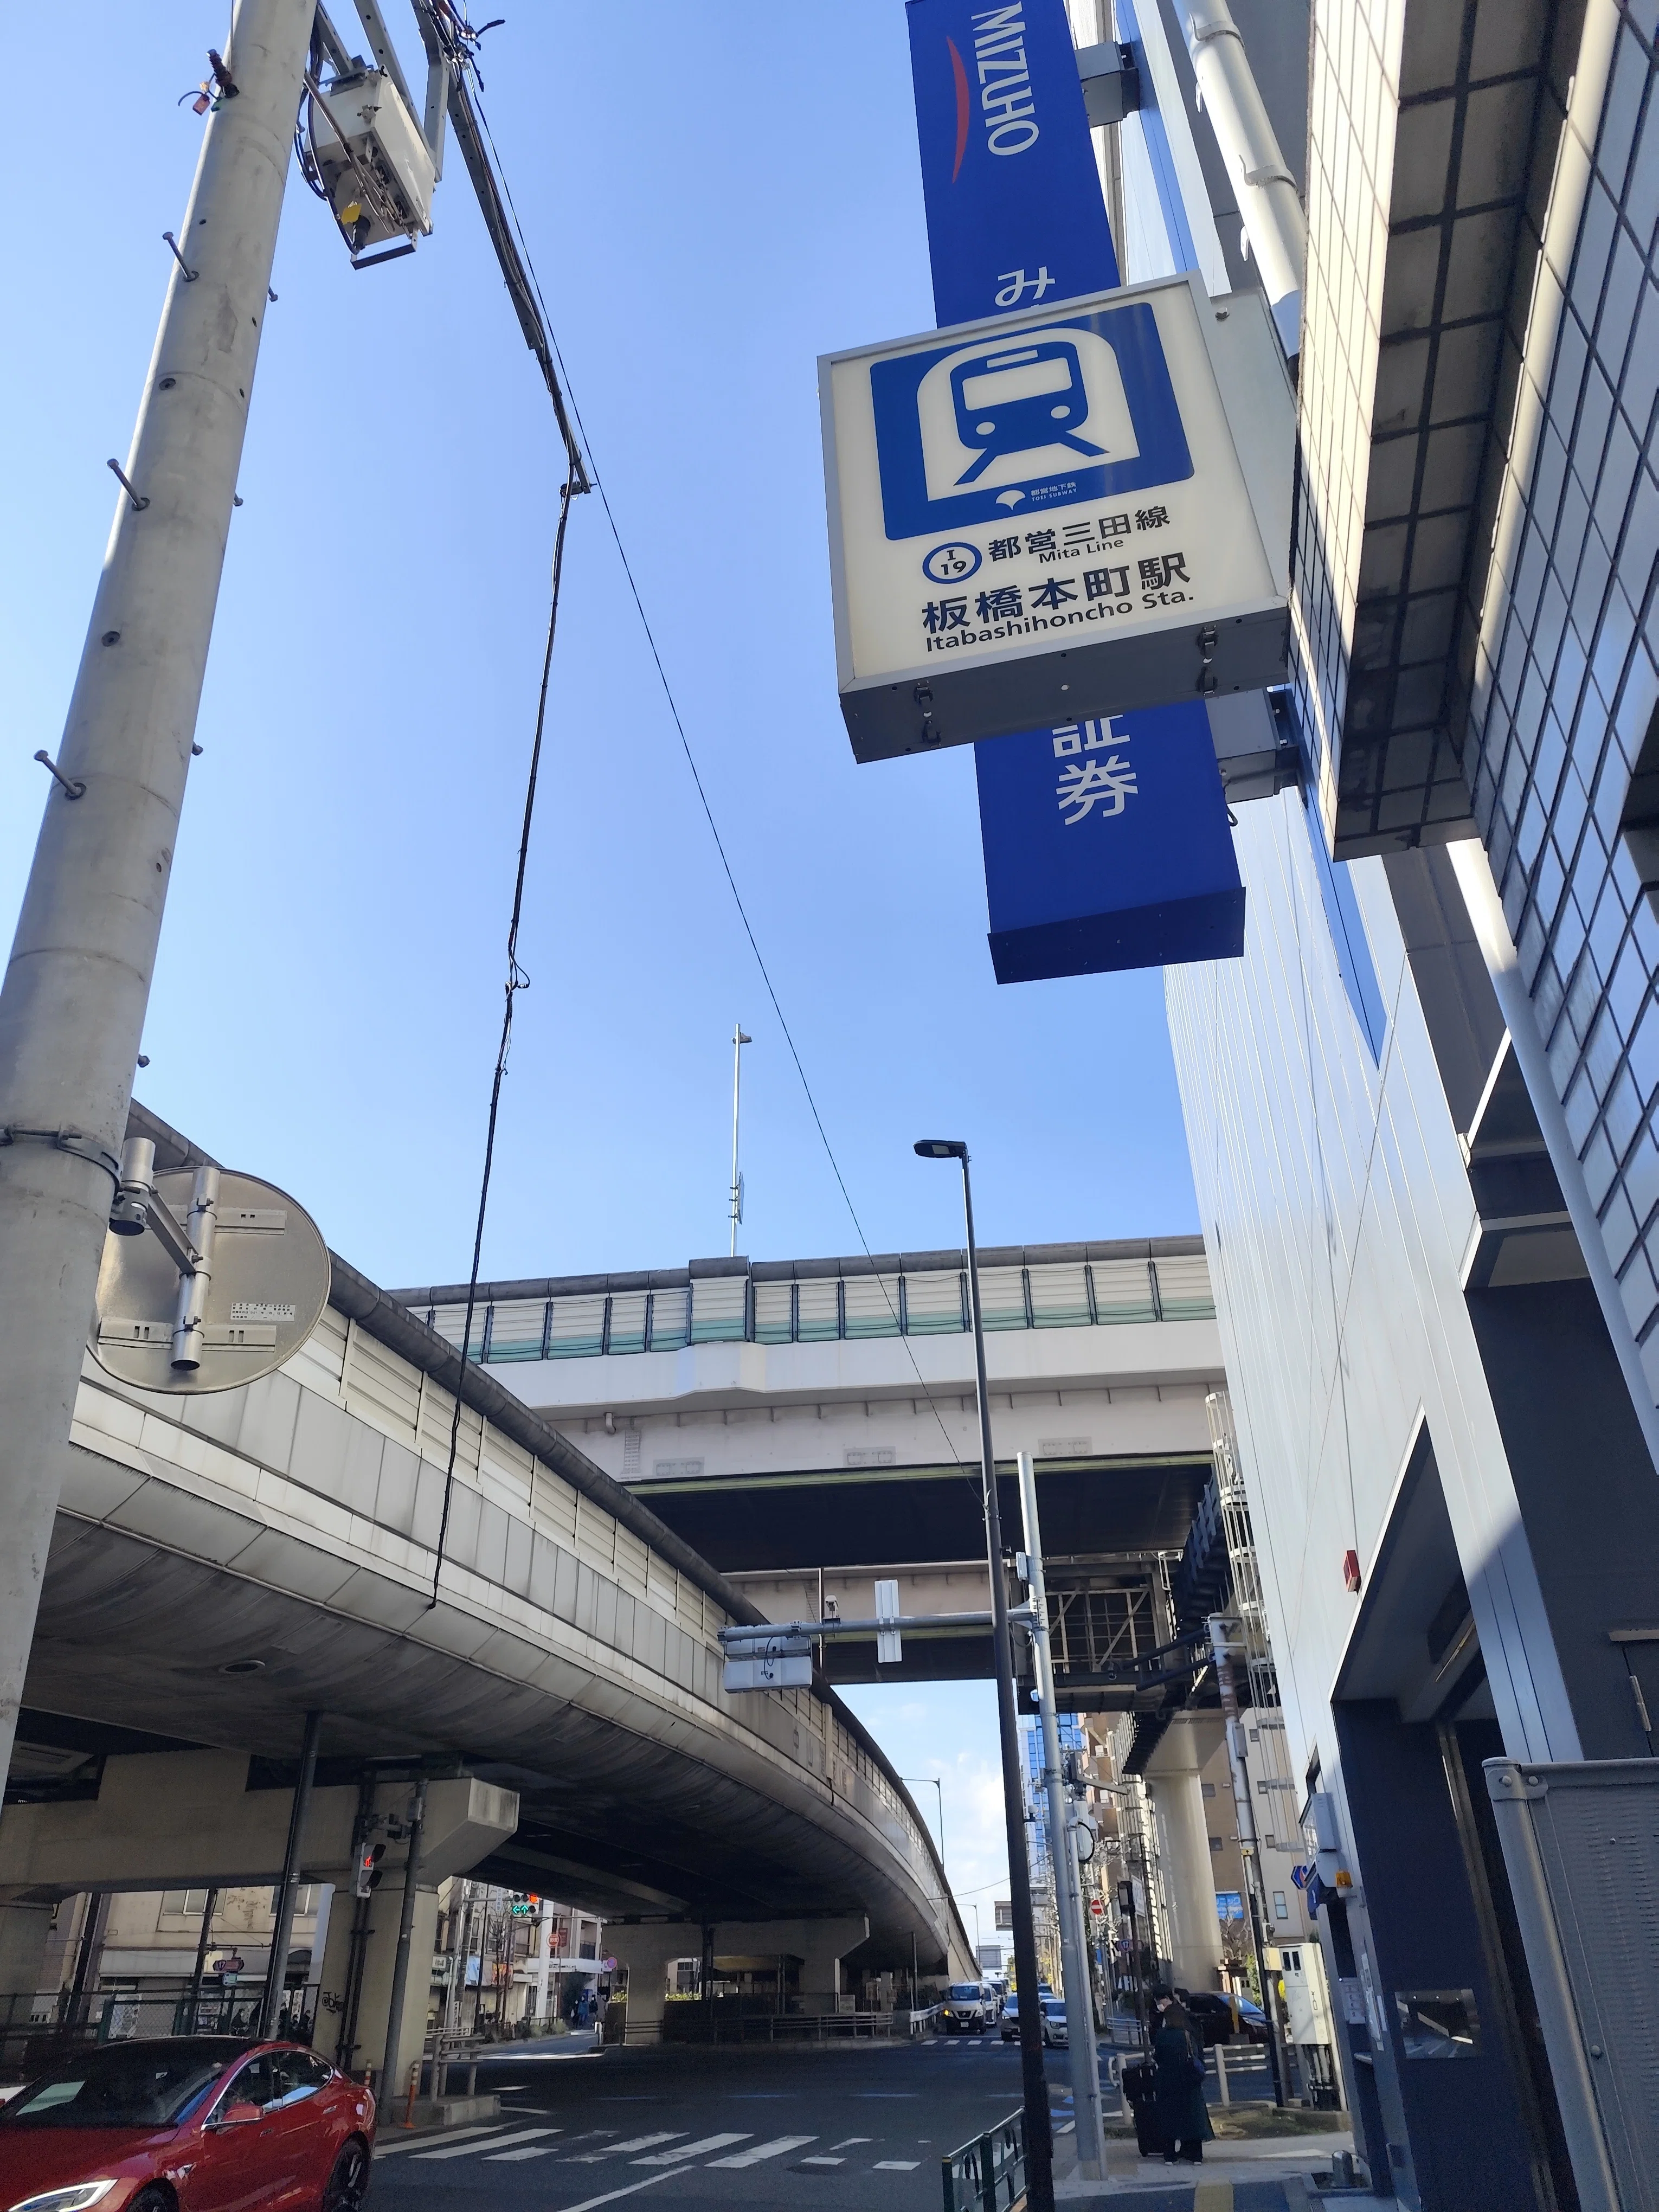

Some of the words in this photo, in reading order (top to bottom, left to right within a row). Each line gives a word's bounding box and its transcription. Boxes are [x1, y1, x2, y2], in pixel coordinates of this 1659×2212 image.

[971, 1, 1039, 156] MIZUHO
[1031, 481, 1076, 496] 都営地下鉄
[1049, 488, 1077, 498] SUBWAY
[988, 506, 1170, 562] 都営三田線
[946, 550, 956, 561] I
[1039, 548, 1081, 563] Mita
[1086, 538, 1124, 554] Line
[941, 560, 967, 575] 19
[922, 552, 1191, 634] 板橋本町駅
[927, 602, 1133, 652] Itabashihoncho
[1144, 591, 1194, 609] Sta.
